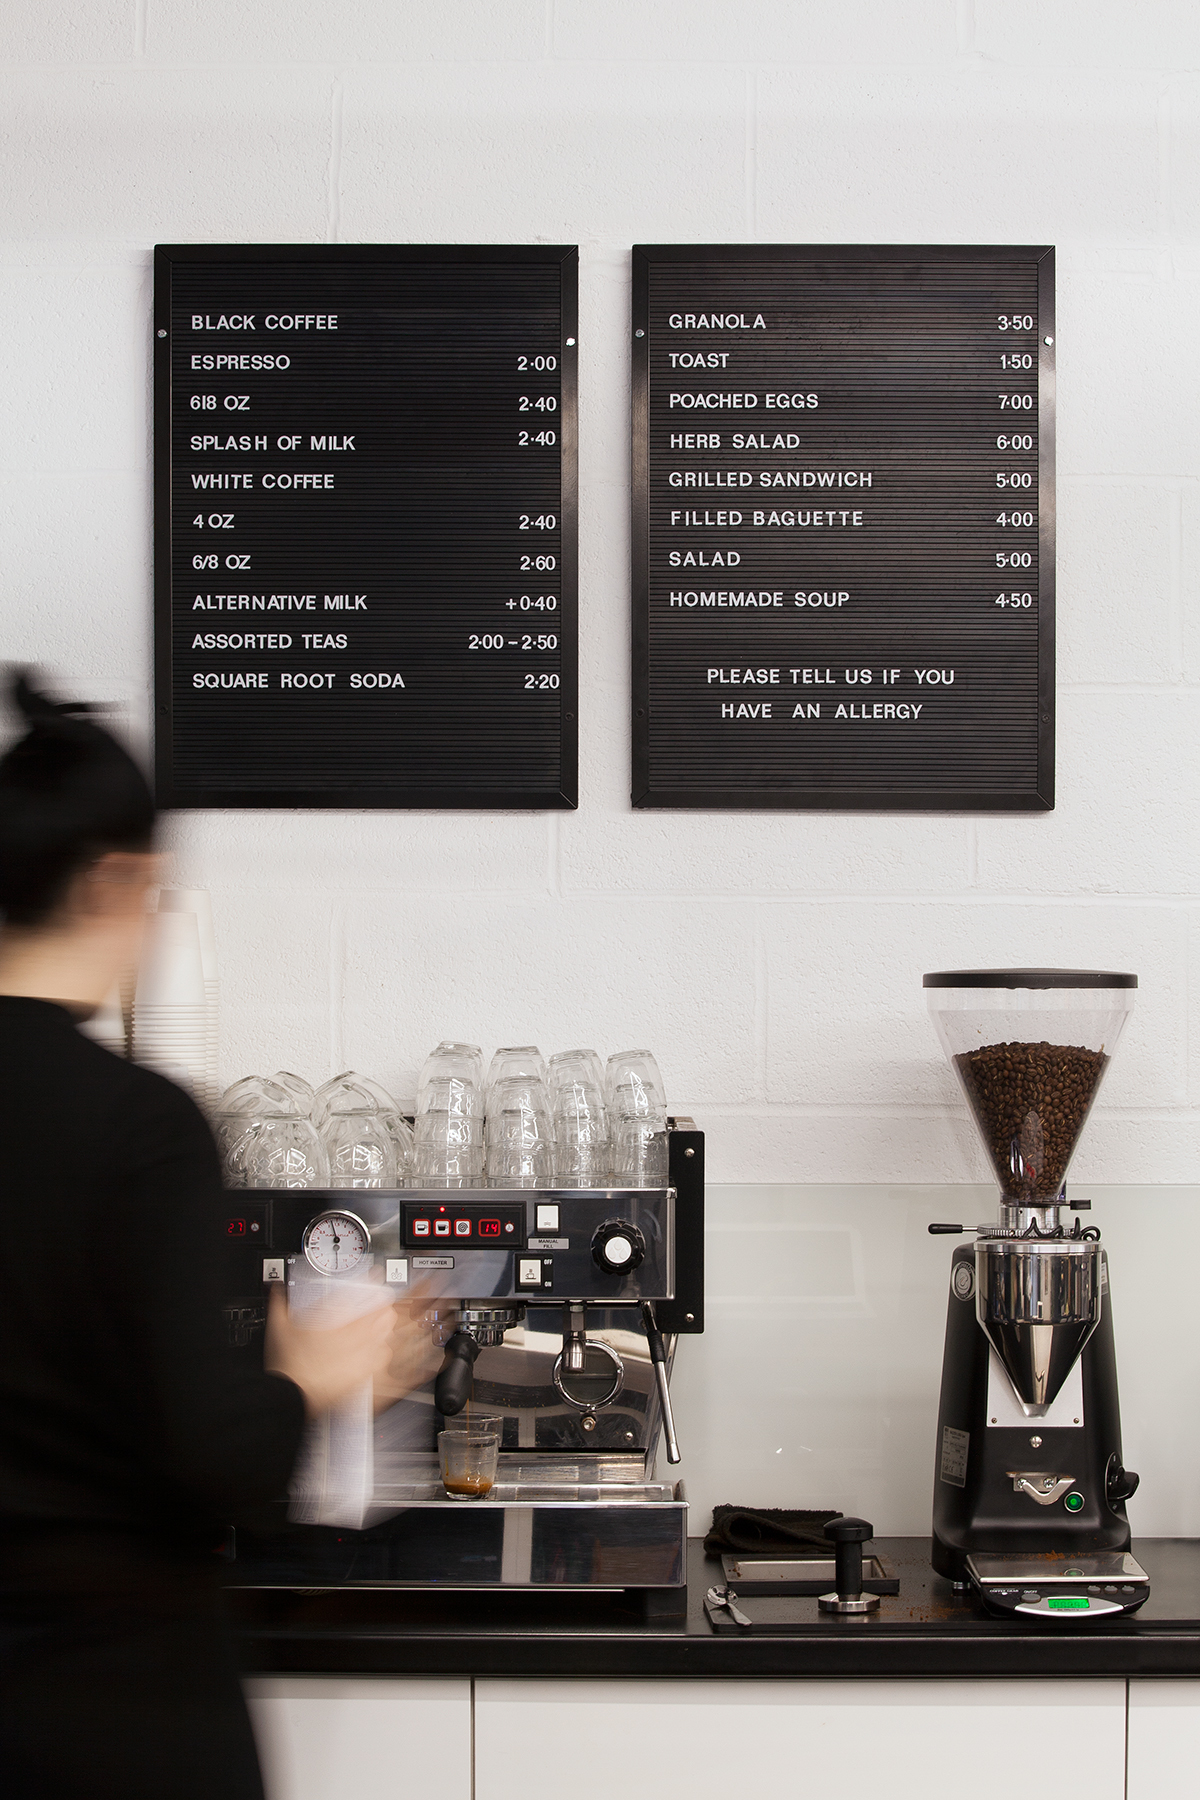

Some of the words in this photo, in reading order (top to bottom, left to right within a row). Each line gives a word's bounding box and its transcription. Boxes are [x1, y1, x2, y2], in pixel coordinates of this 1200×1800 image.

[191, 314, 256, 330] BLACK
[264, 314, 338, 330] COFFEE
[668, 313, 767, 330] GRANOLA
[191, 354, 291, 371] ESPRESSO
[668, 352, 730, 369] TOAST
[223, 395, 251, 411] OZ
[669, 393, 758, 409] POACHED
[765, 393, 819, 409] EGGS
[190, 435, 268, 451] SPLASH
[277, 435, 302, 451] OF
[310, 435, 356, 451] MILK
[670, 433, 721, 449] HERB
[732, 433, 800, 450] SALAD
[191, 473, 254, 490] WHITE
[261, 473, 335, 490] COFFEE
[668, 471, 753, 488] GRILLED
[759, 471, 872, 488] SANDWICH
[192, 513, 204, 529] 4
[207, 513, 235, 529] OZ
[670, 510, 743, 527] FILLED
[753, 510, 864, 527] BAGUETTE
[192, 554, 219, 570] 6/8
[225, 554, 251, 570] OZ
[668, 551, 741, 567] SALAD
[192, 594, 317, 611] ALTERNATIVE
[324, 594, 368, 610] MILK
[670, 591, 784, 608] HOMEMADE
[794, 591, 850, 608] SOUP
[191, 633, 293, 650] ASSORTED
[301, 633, 348, 649] TEAS
[192, 673, 269, 689] SQUARE
[280, 673, 336, 689] ROOT
[349, 673, 406, 689] SODA
[707, 668, 780, 685] PLEASE
[789, 668, 836, 685] TELL
[845, 668, 873, 685] US
[882, 668, 901, 685] IF
[913, 669, 955, 685] YOU
[721, 703, 772, 719] HAVE
[791, 702, 821, 719] AN
[834, 703, 923, 720] ALLERGY
[227, 1222, 243, 1233] 27
[485, 1223, 498, 1233] 14
